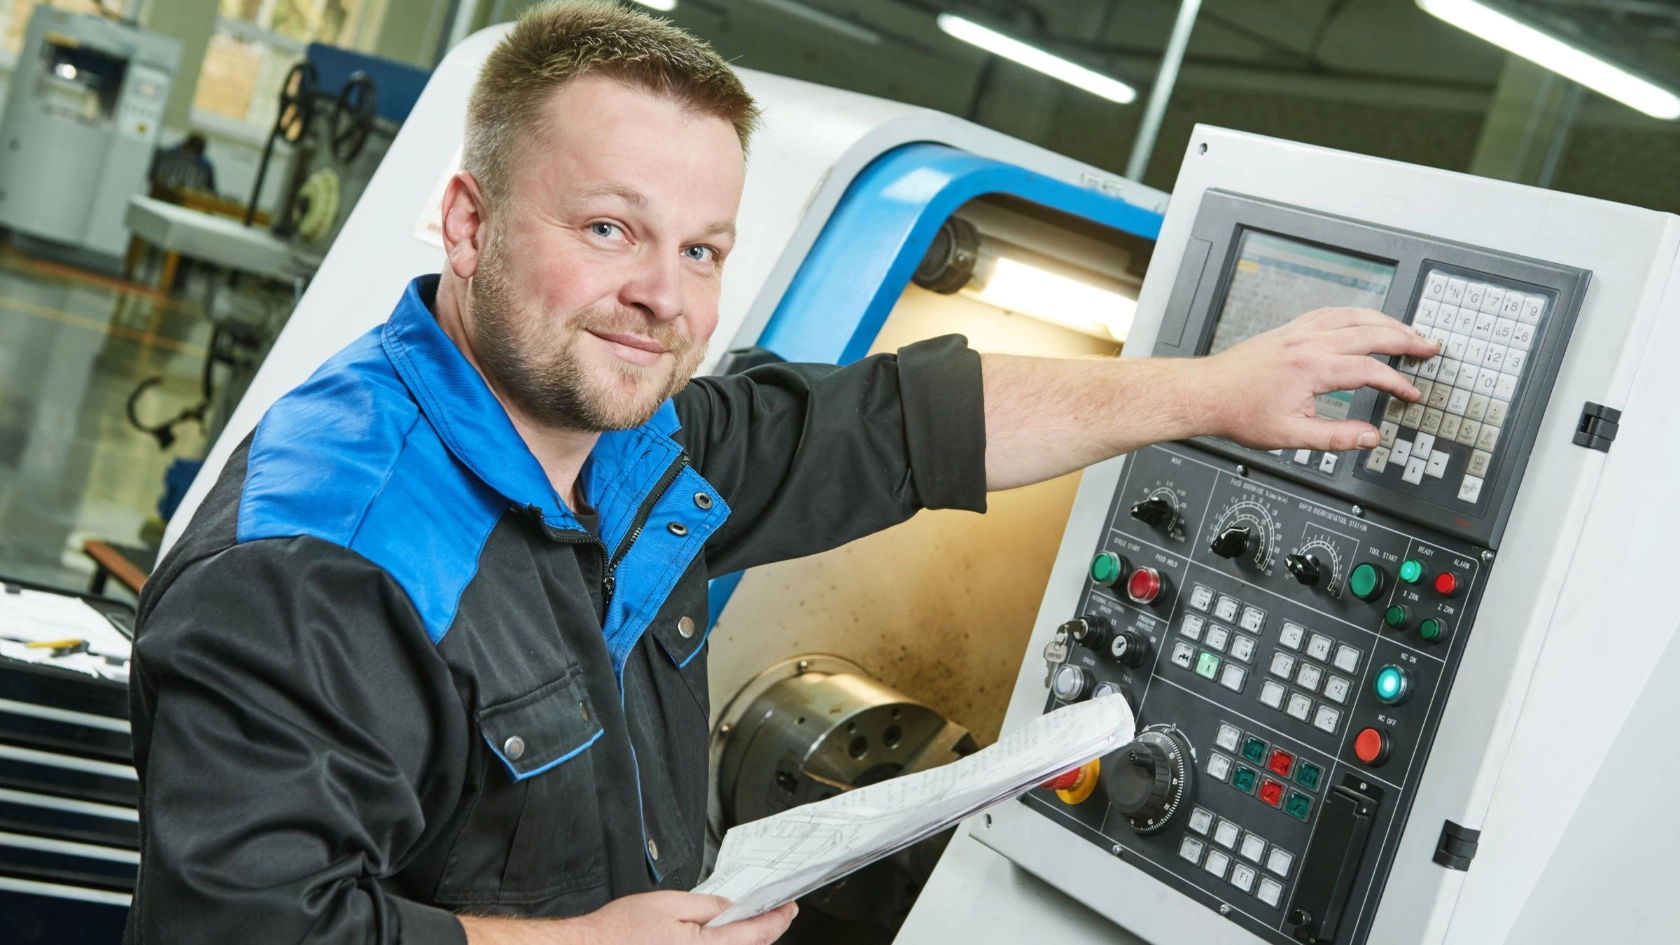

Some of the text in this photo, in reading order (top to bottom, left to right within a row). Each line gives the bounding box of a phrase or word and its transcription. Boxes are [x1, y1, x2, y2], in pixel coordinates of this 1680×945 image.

[1452, 288, 1461, 299] N
[1470, 294, 1479, 304] G
[1491, 296, 1500, 306] 7
[1510, 302, 1519, 312] 8
[1530, 306, 1538, 316] 9
[1425, 308, 1434, 319] X
[1444, 313, 1452, 324] Z
[1462, 318, 1470, 328] F
[1482, 322, 1491, 332] 4
[1502, 327, 1510, 337] 5
[1521, 332, 1530, 342] 6
[1455, 342, 1463, 353] T
[1492, 352, 1502, 362] 2
[1512, 357, 1520, 368] 3
[1427, 362, 1436, 373] W
[1230, 478, 1242, 488] FEED
[1242, 482, 1264, 495] OVERRIDE
[1298, 502, 1312, 512] RAPID
[1348, 520, 1368, 532] STATION
[1114, 537, 1141, 552] CYCLE START
[1368, 546, 1398, 563] TOOL START
[1418, 546, 1435, 556] READY
[1156, 554, 1178, 568] FEED HOLD
[1453, 558, 1470, 570] ALARM
[1408, 592, 1419, 602] ZRN
[1444, 606, 1454, 615] ZRN
[1138, 614, 1156, 626] PROGRAM
[1136, 621, 1154, 632] PROTECT
[1317, 644, 1326, 653] +X
[1400, 652, 1418, 664] NC ON
[1334, 686, 1344, 694] +Z
[1298, 703, 1306, 711] -X
[1325, 716, 1332, 725] -C
[1378, 714, 1398, 726] NC OFF
[1240, 872, 1249, 884] F1
